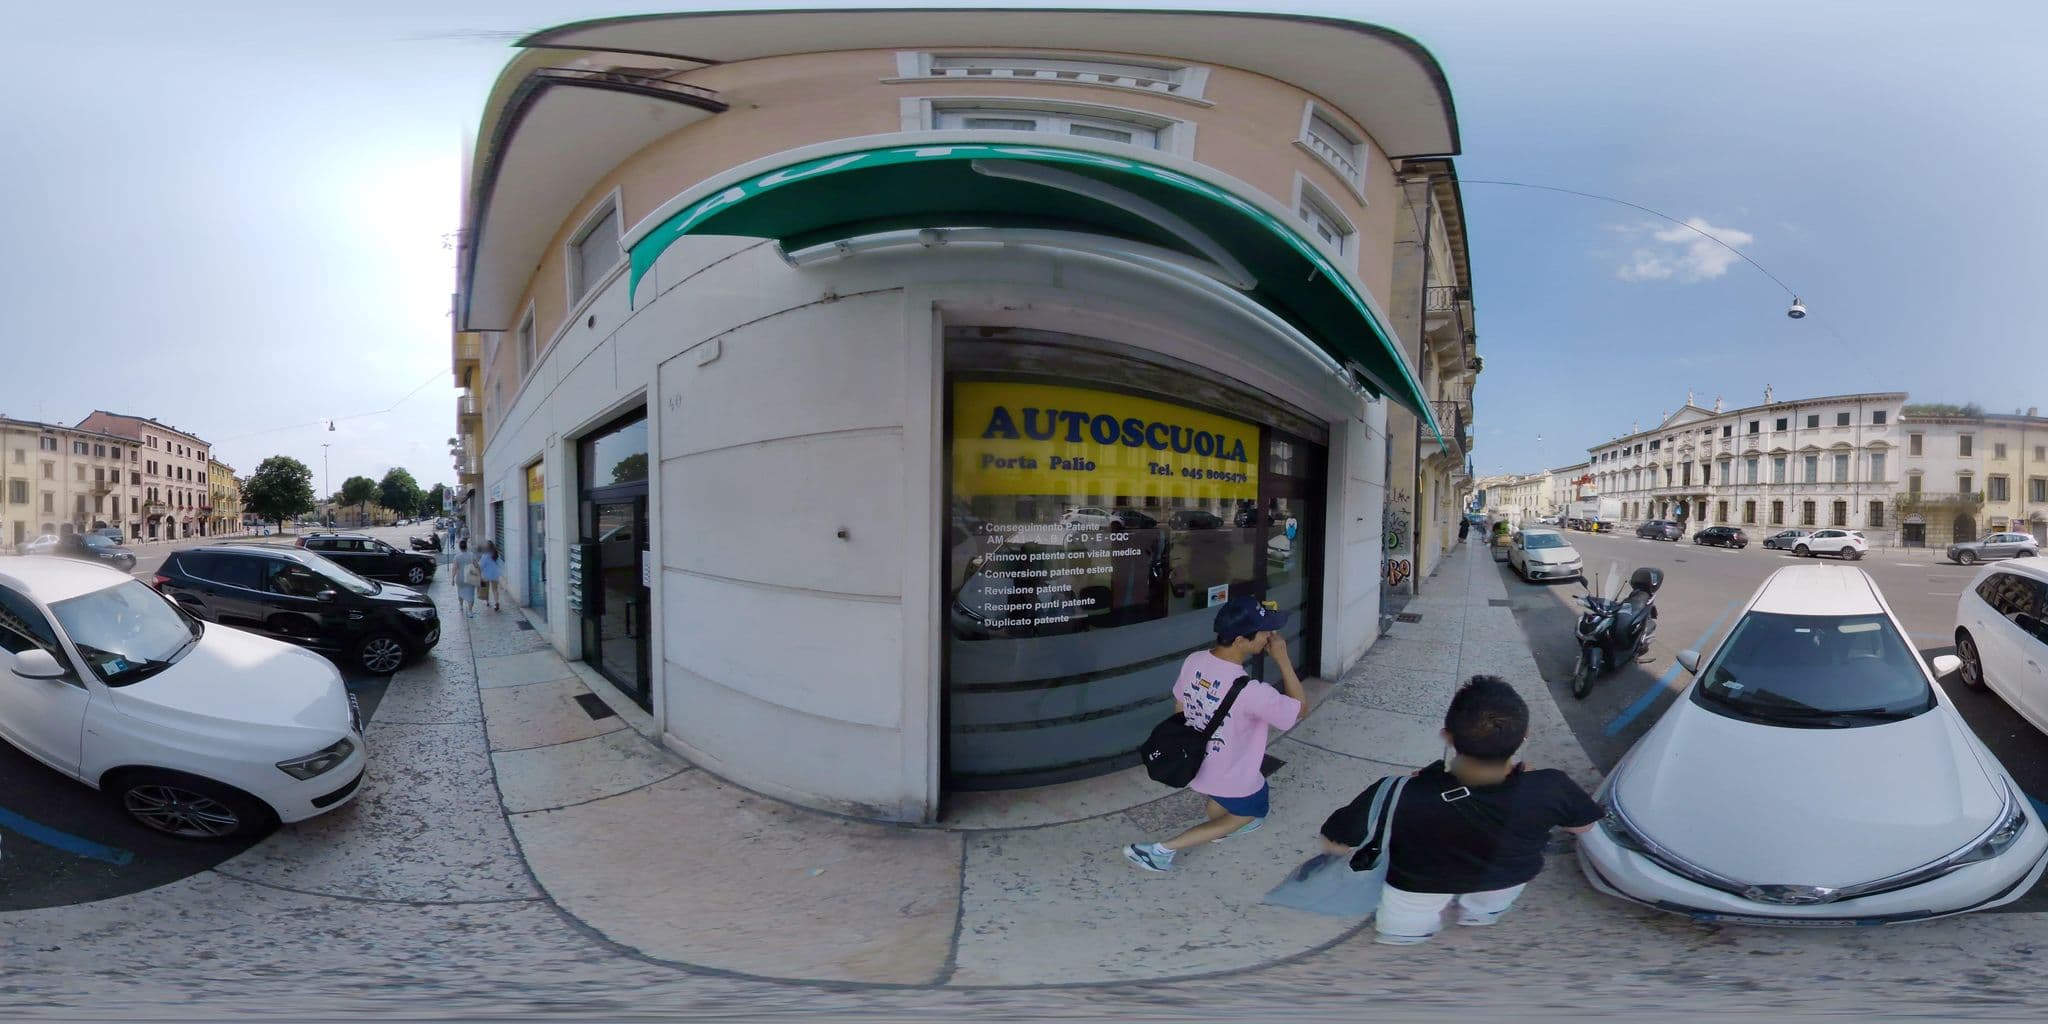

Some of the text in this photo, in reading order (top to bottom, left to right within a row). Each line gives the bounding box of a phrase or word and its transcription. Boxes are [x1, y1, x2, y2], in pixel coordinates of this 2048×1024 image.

[981, 406, 1248, 463] AUTOSCUOLA
[981, 453, 1096, 472] Porta Palio
[1148, 462, 1174, 476] Tel.
[1181, 467, 1203, 480] 045
[985, 522, 1100, 534] Conseguimento Patente
[987, 535, 1004, 544] AM
[1066, 533, 1073, 543] C
[1081, 533, 1089, 543] D
[1096, 533, 1103, 542] E
[1110, 532, 1129, 542] CQC
[985, 548, 1142, 563] Rinnovo patente con visita medica
[984, 565, 1114, 579] Conversione patente estera
[984, 583, 1072, 596] Revisione patente
[984, 597, 1096, 613] Recupero punti patente
[984, 614, 1070, 628] Duplicato patente
